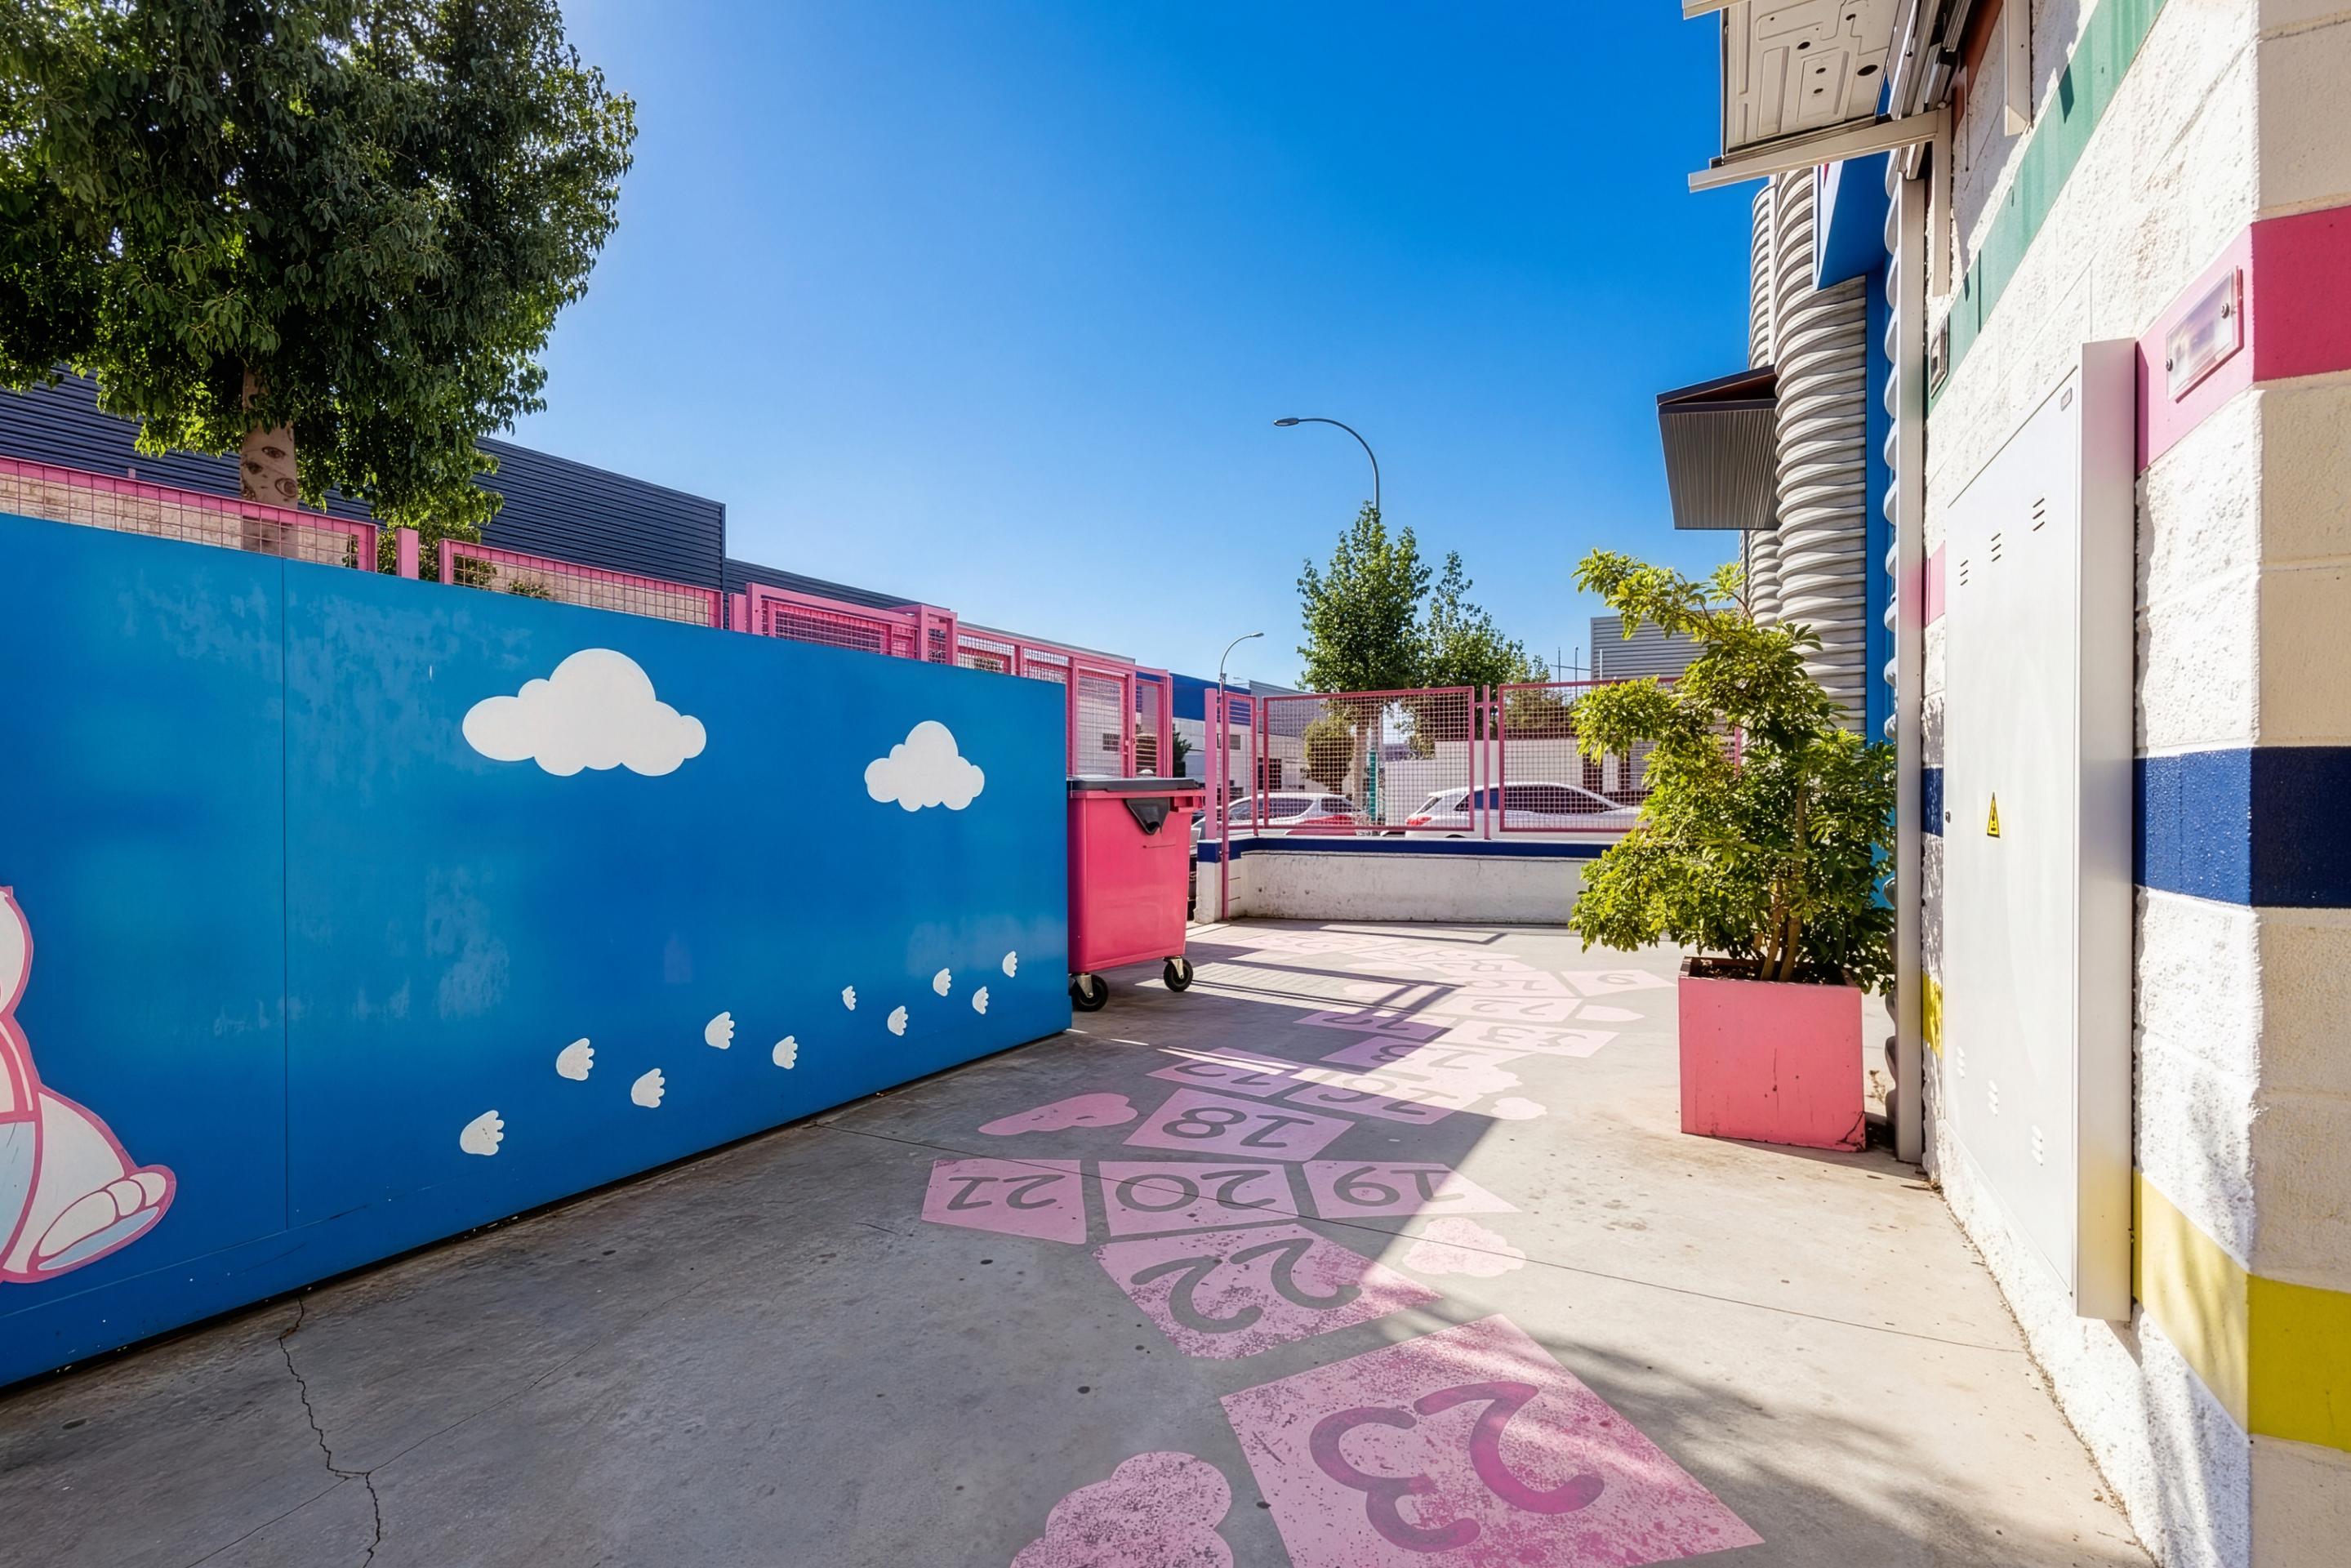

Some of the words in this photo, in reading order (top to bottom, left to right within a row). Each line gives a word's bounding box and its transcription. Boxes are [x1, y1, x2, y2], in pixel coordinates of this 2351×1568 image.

[1317, 1076, 1459, 1116] 16
[1162, 1107, 1315, 1148] 18
[946, 1174, 1066, 1211] 21
[1115, 1169, 1276, 1213] 20
[1334, 1165, 1465, 1206] 19
[1130, 1237, 1363, 1334] 22
[1308, 1380, 1604, 1553] 23
